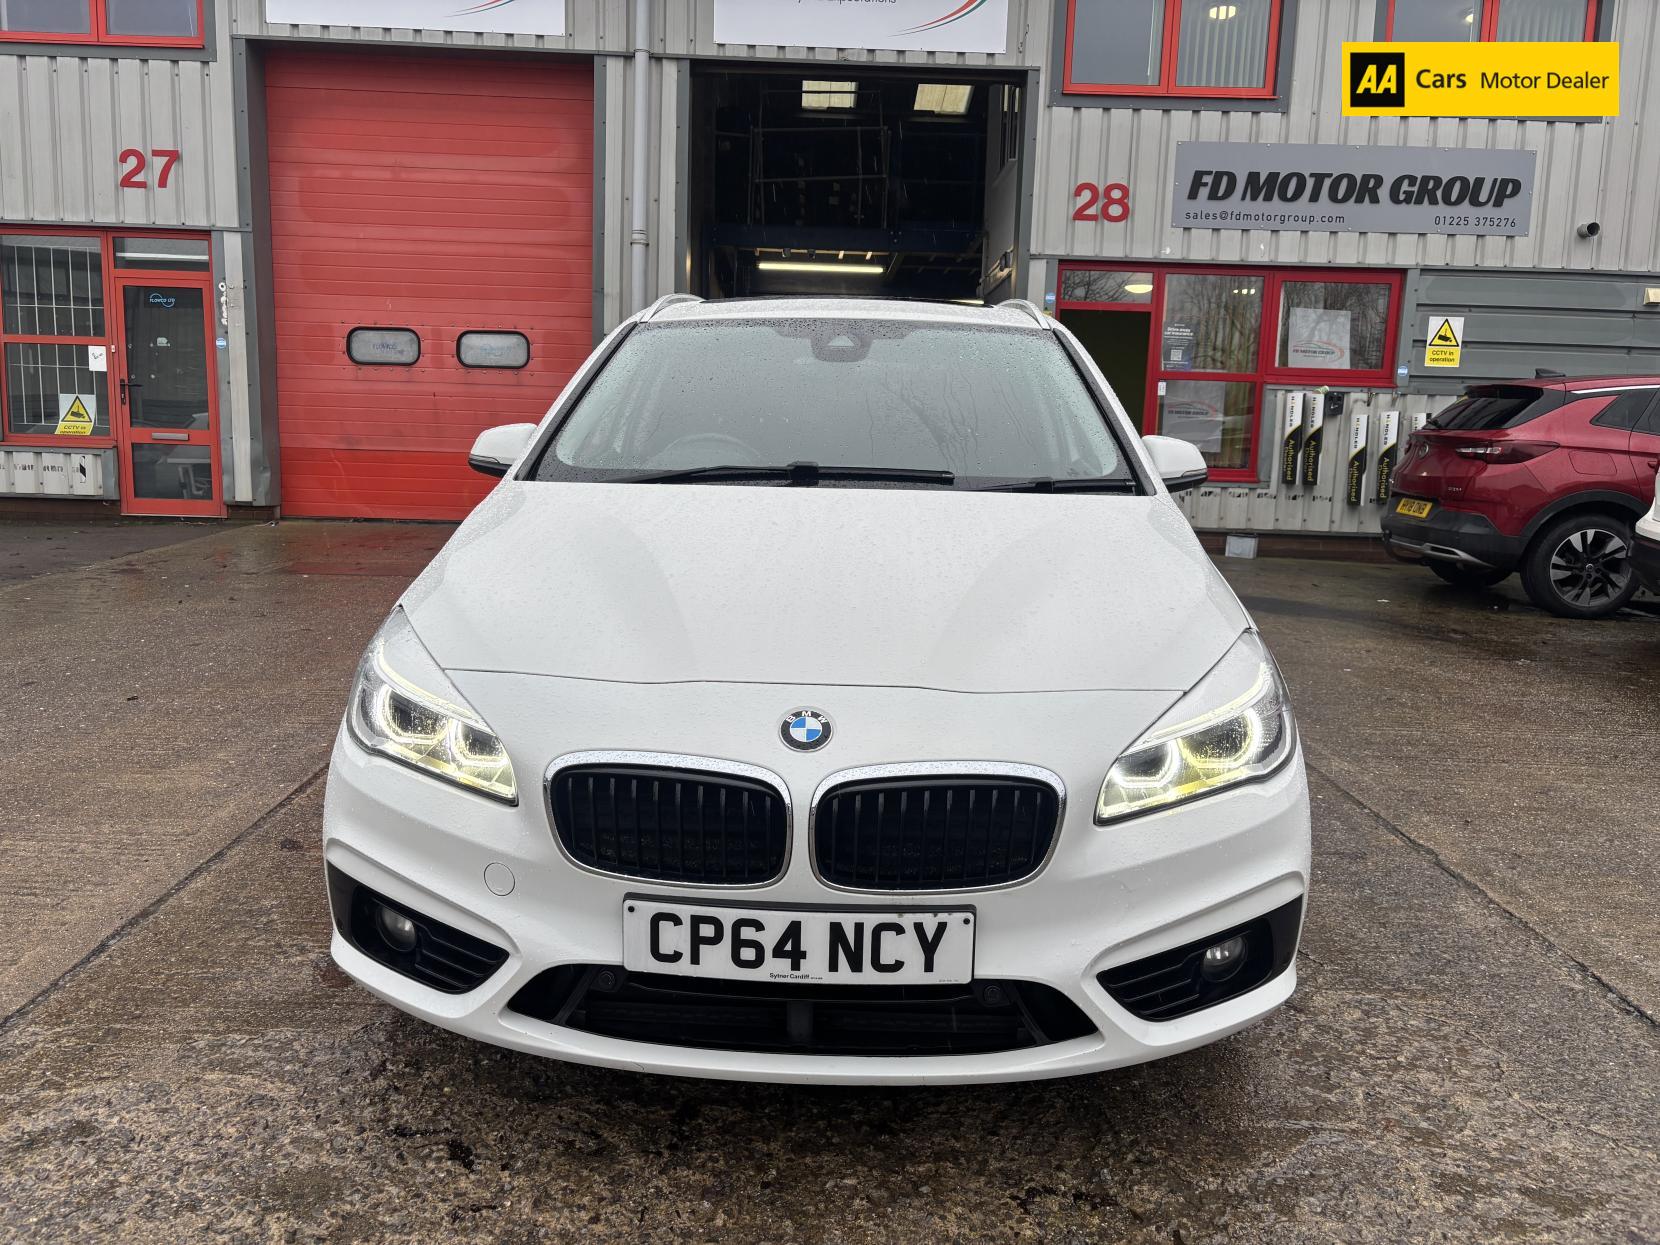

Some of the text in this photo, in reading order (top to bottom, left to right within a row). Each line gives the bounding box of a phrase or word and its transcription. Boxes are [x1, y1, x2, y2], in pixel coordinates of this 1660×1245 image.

[119, 149, 179, 188] 27
[1072, 182, 1130, 223] 28
[1187, 170, 1522, 208] FD MOTOR GROUP
[1185, 210, 1345, 224] sales@fdmotorgroup.com
[1434, 216, 1516, 228] 01225 375276
[785, 710, 829, 723] BMW
[650, 911, 948, 973] CP64 NCY
